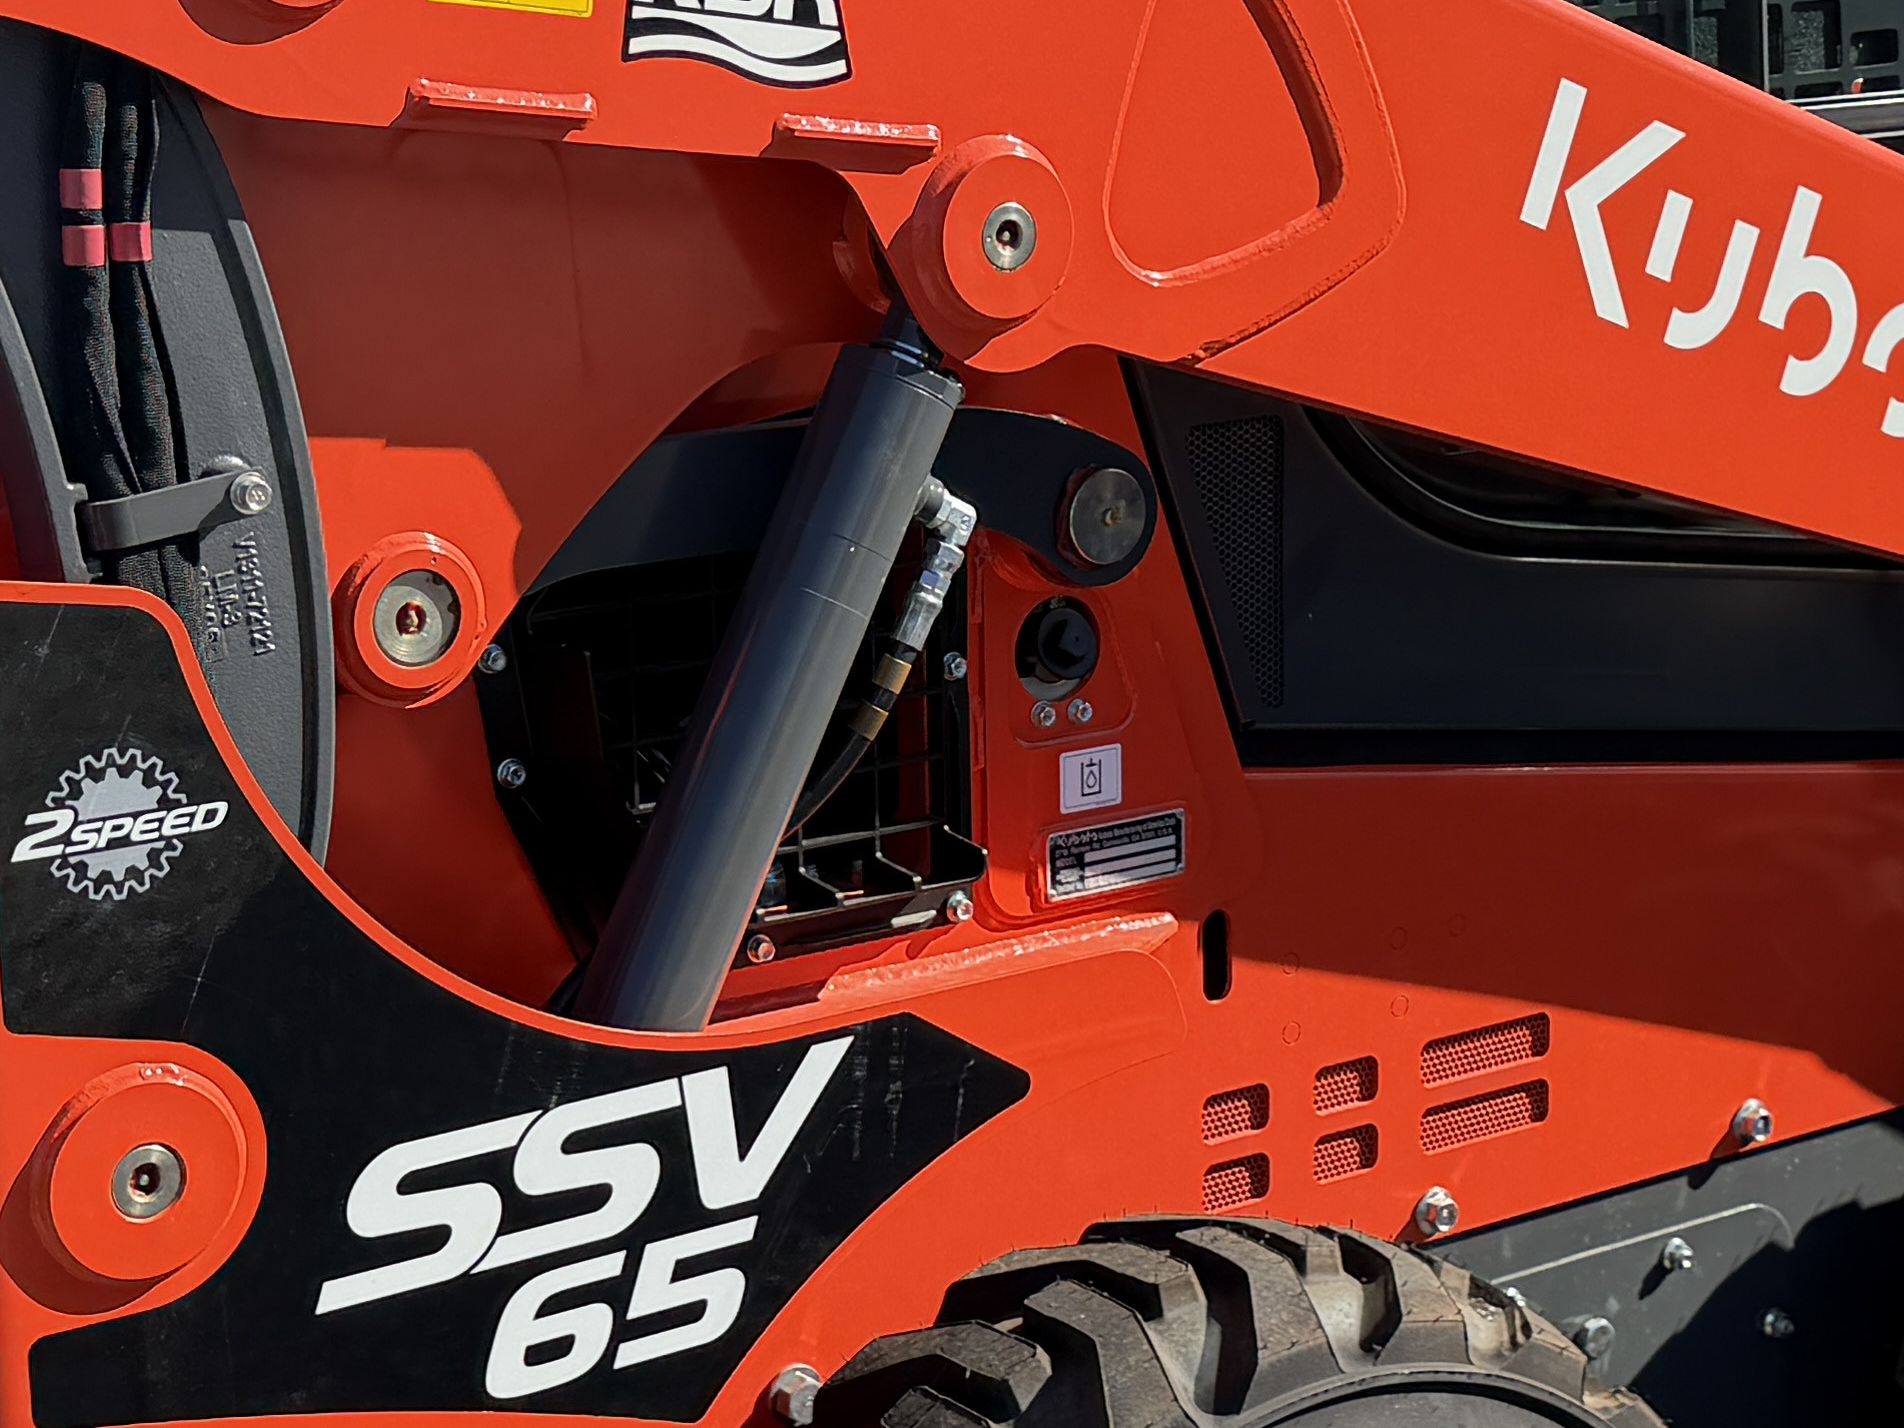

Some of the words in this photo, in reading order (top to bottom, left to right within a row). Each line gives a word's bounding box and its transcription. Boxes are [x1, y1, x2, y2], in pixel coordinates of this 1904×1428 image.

[10, 799, 229, 865] 2SPEED
[315, 1035, 854, 1314] SSV
[484, 1214, 759, 1399] 65
